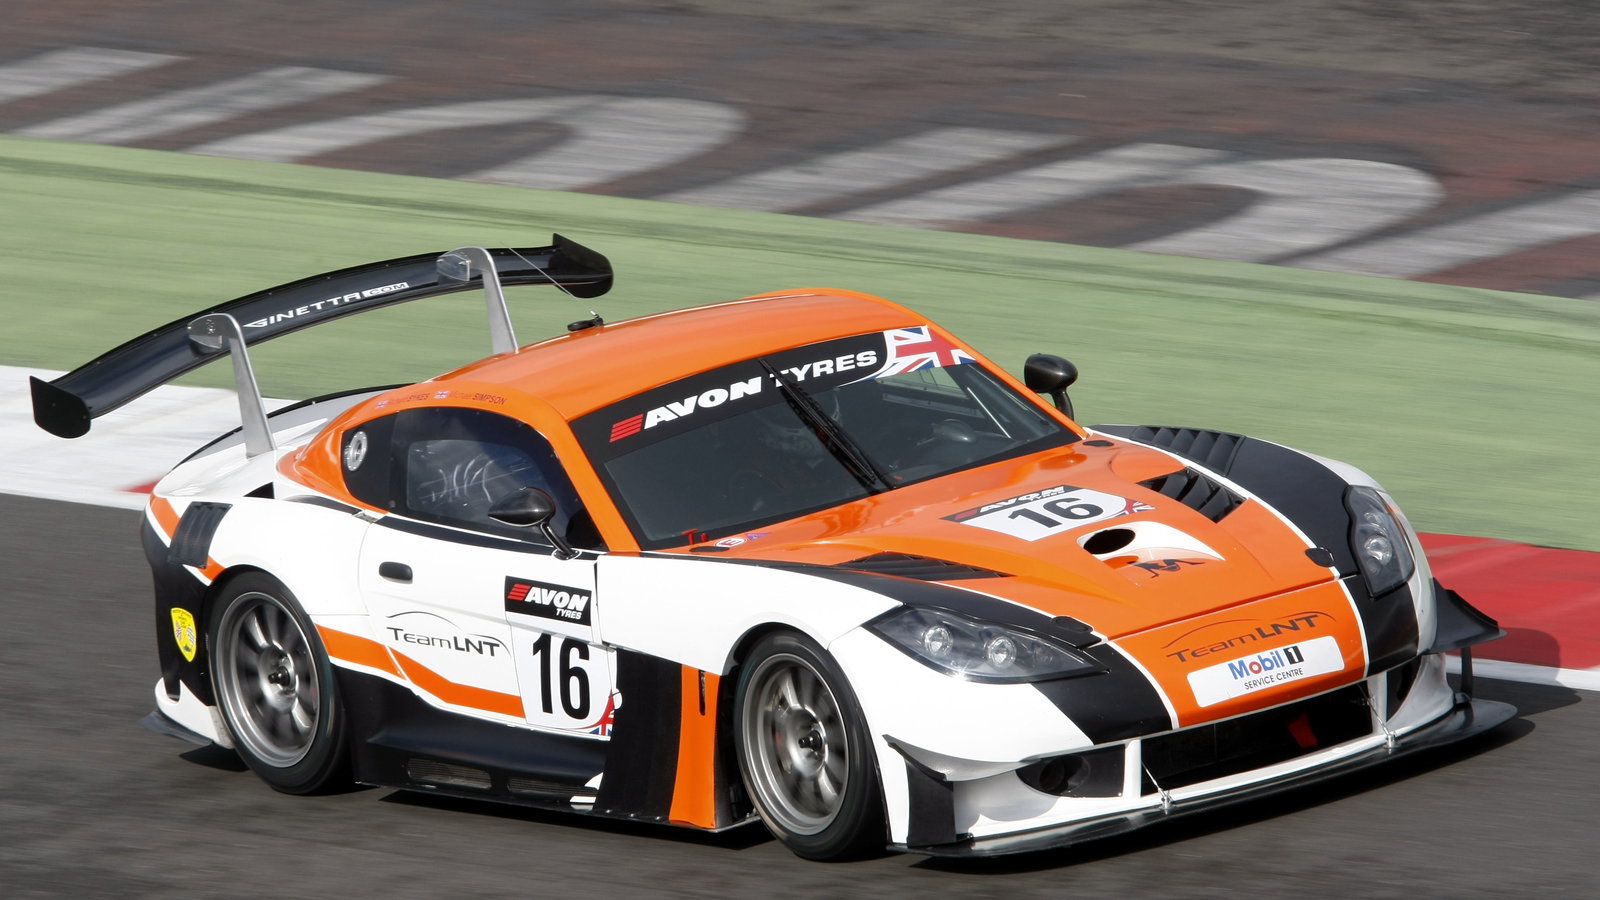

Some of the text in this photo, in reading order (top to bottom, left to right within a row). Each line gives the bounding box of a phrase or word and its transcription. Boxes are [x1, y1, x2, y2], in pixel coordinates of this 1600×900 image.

[644, 350, 878, 430] AVON TYRES
[979, 486, 1066, 513] AVON
[1007, 497, 1104, 529] 16
[524, 586, 589, 611] AVON
[556, 607, 582, 620] TYRES
[386, 626, 501, 657] TeamLNT
[1166, 614, 1319, 663] TeamLNT
[532, 632, 591, 720] 16
[1227, 646, 1303, 681] Mobil 1
[1244, 668, 1304, 690] SERVICE CENTRE
